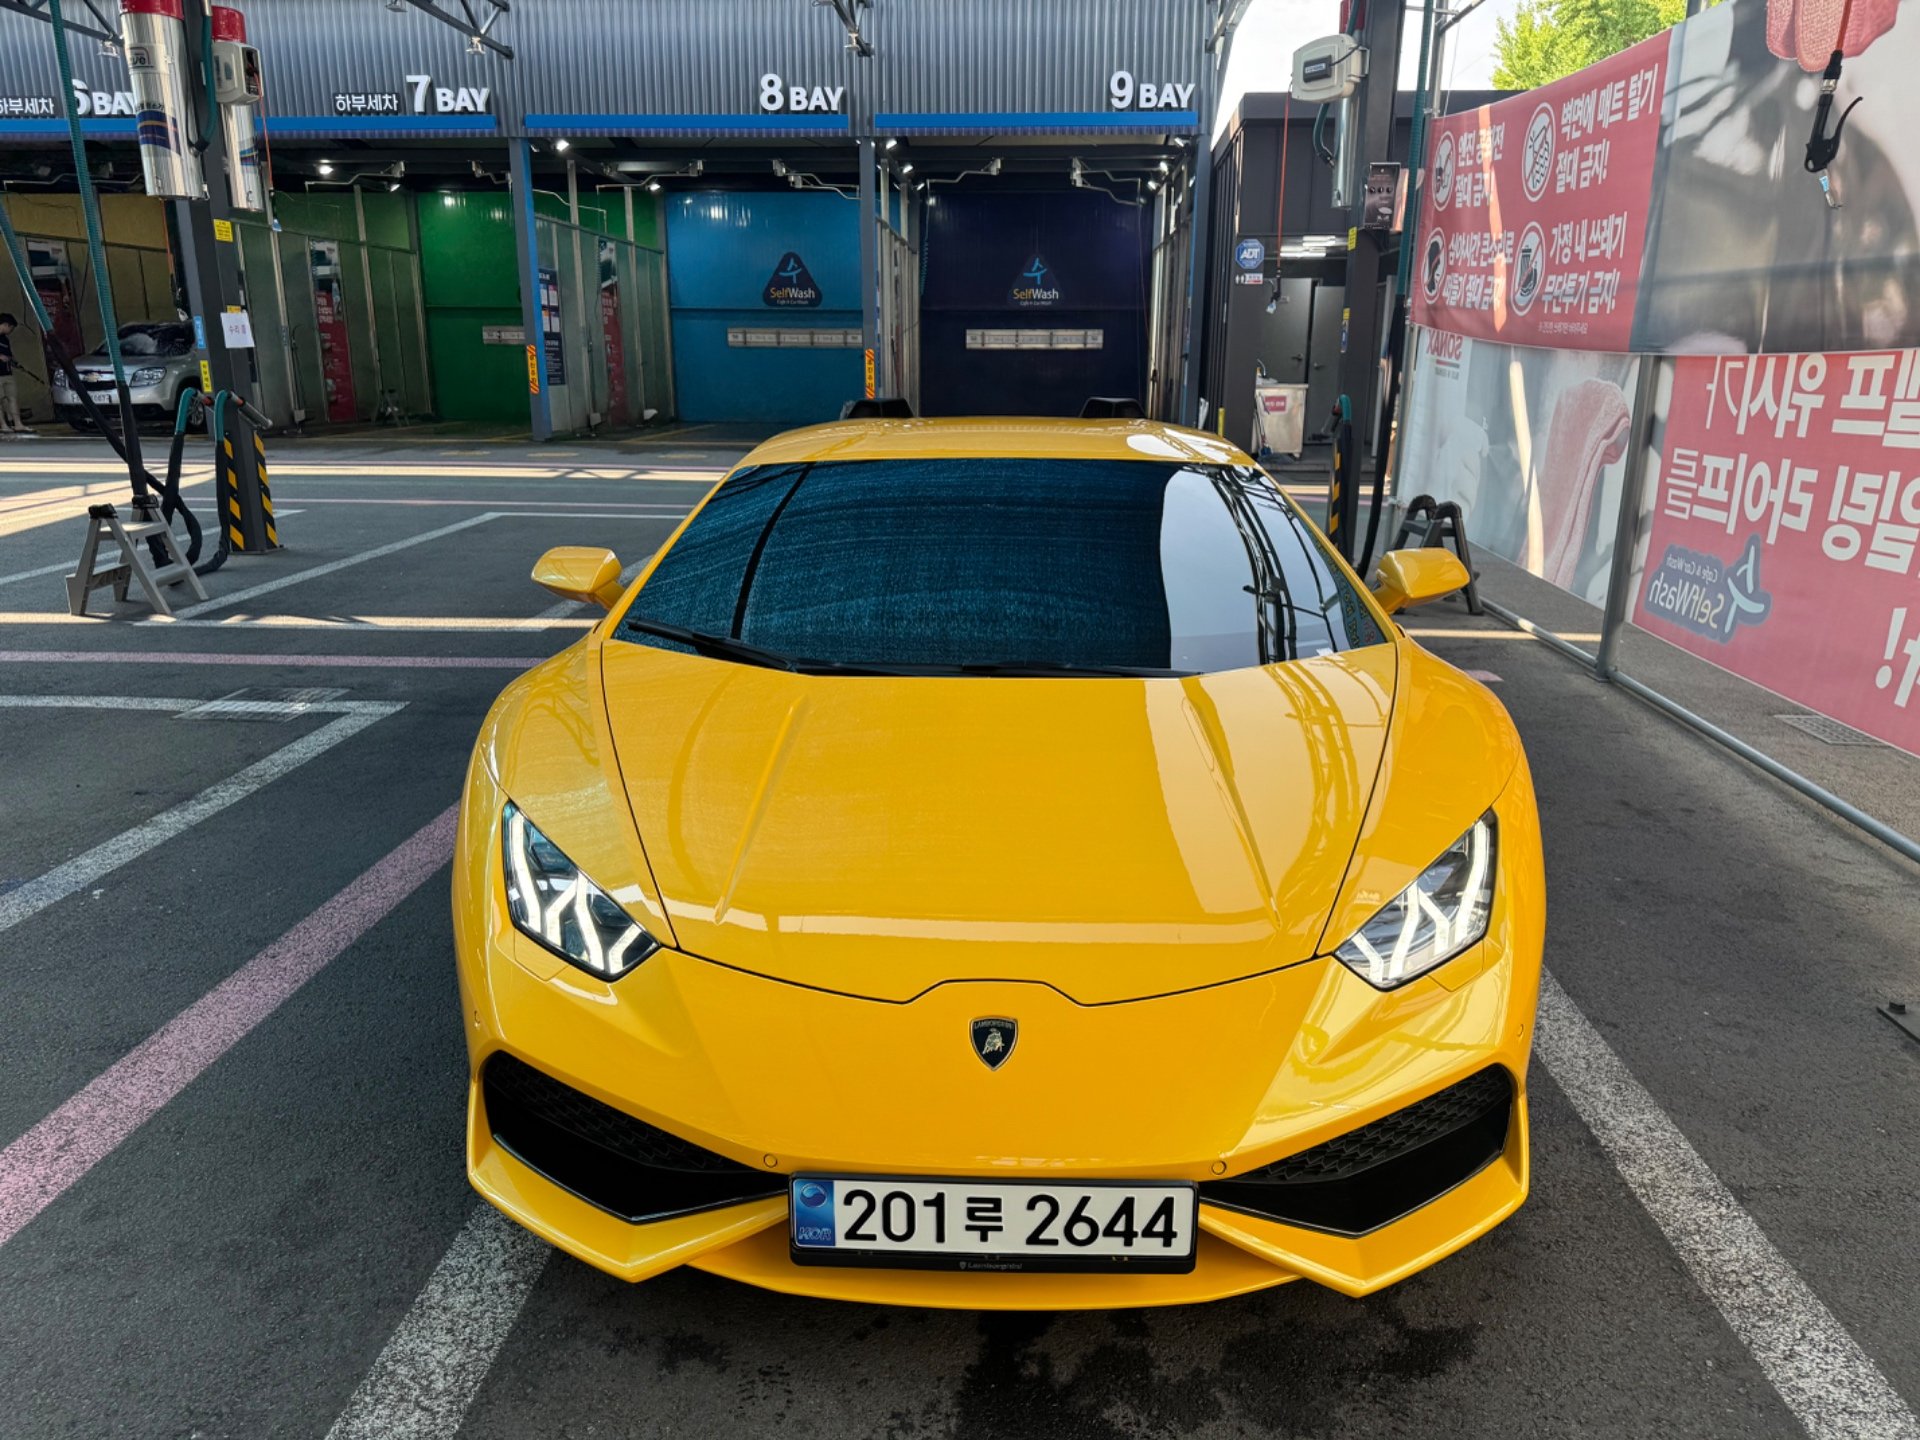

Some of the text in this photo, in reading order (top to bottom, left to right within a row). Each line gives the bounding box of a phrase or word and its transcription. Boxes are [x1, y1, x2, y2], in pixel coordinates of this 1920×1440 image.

[0, 98, 54, 115] 하부세차
[335, 75, 490, 112] 하부세차 7 BAY
[760, 74, 844, 111] 8 BAY
[1110, 71, 1196, 109] 9 BAY
[1561, 63, 1659, 142] 벽면에 매트 털기
[1458, 130, 1476, 167] 엔진
[1555, 138, 1611, 194] 절대 금지!
[1455, 171, 1473, 208] 절대
[1239, 248, 1260, 259] ADT
[1550, 211, 1628, 265] 가정 내 쓰레기
[770, 287, 815, 300] SelfWash
[1013, 288, 1059, 301] SelfWash
[1542, 268, 1620, 315] 무단투기 금지!
[798, 1226, 832, 1241] KOR
[842, 1188, 1178, 1248] 201루 2644
